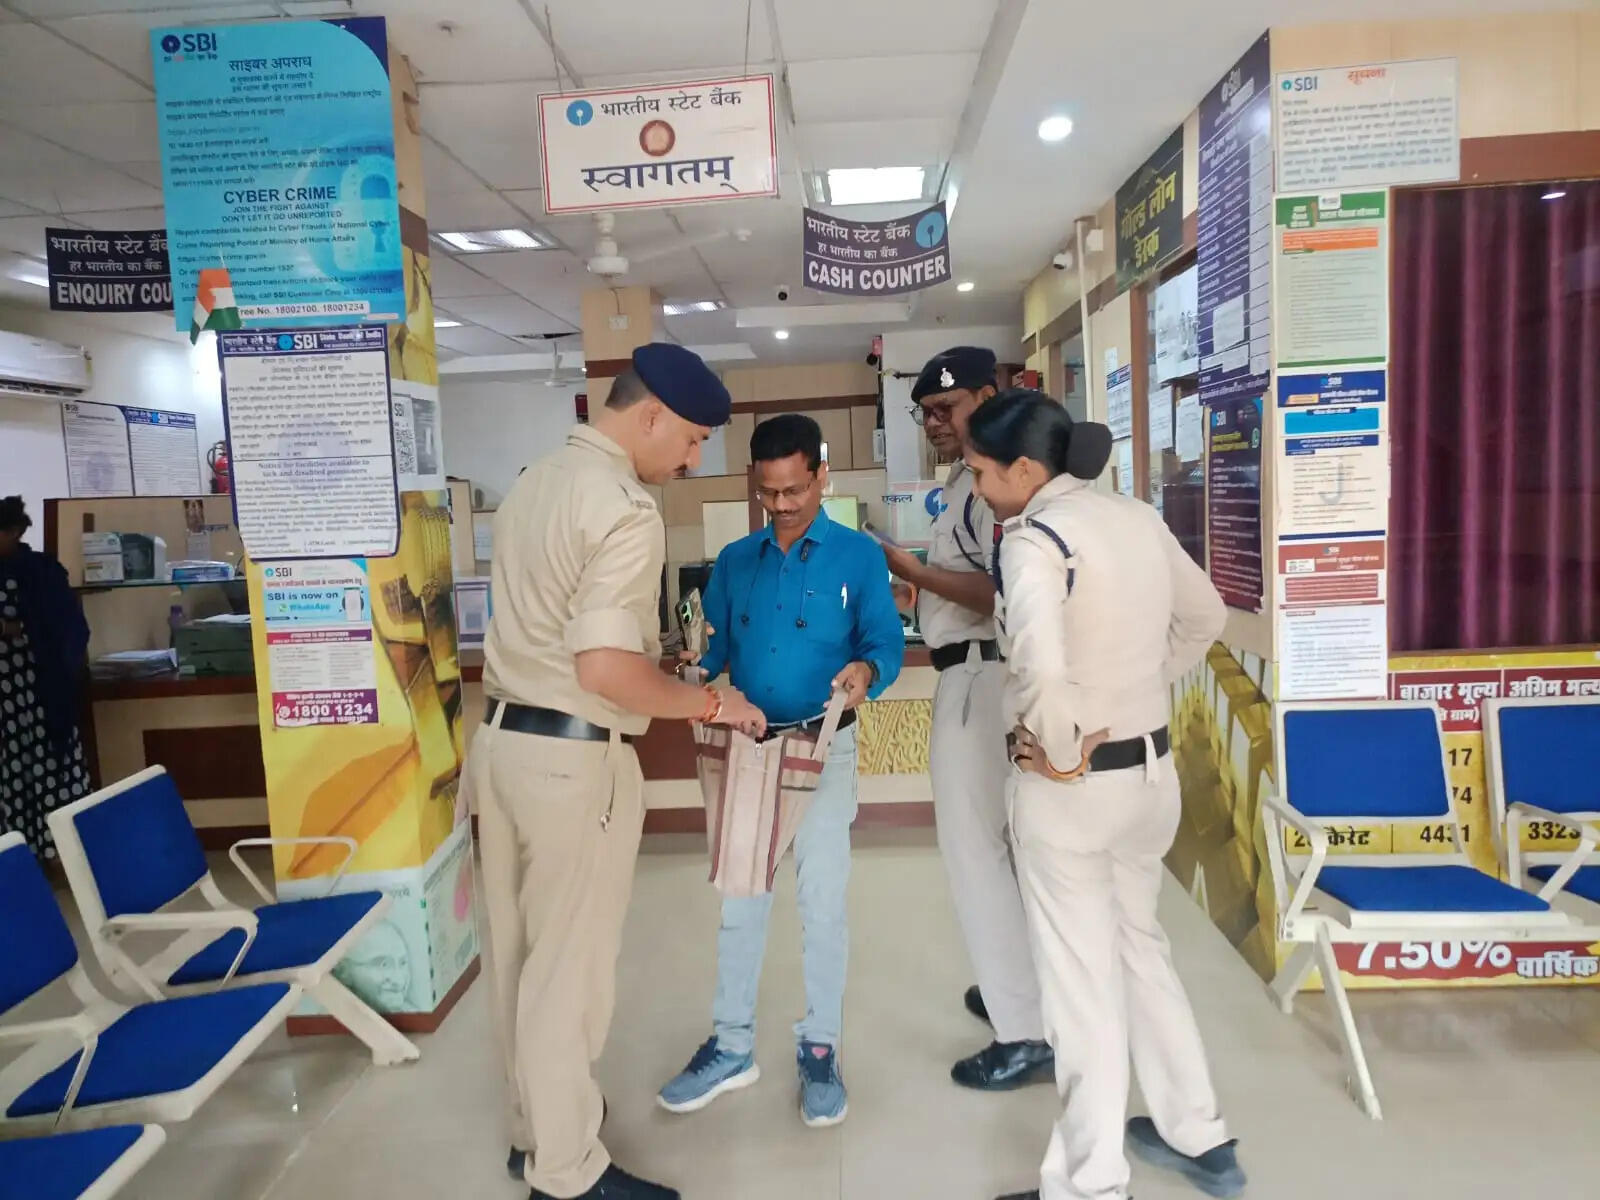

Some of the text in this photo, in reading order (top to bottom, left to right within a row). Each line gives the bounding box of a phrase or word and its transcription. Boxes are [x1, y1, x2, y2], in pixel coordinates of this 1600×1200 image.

[183, 33, 217, 53] SBI
[228, 57, 267, 72] साइबर
[271, 55, 312, 70] अपराध
[1294, 76, 1318, 91] SBI
[601, 87, 743, 117] भारतीय स्टेट बैंक
[581, 156, 740, 192] स्वागतम्
[223, 186, 337, 204] CYBER CRIME
[233, 202, 330, 214] JOIN THE FIGHT AGAINST
[287, 211, 342, 219] UNREPORTED
[806, 216, 911, 243] भारतीय स्टेट बैंक
[50, 235, 109, 254] भारतीय
[114, 234, 145, 255] स्टेट
[830, 244, 861, 259] भारतीय
[864, 248, 877, 259] का
[85, 259, 124, 272] भारतीय
[127, 261, 141, 272] का
[808, 254, 947, 290] CASH COUNTER
[57, 281, 136, 306] ENQUIRY
[239, 307, 254, 316] ree
[294, 333, 318, 350] SBI
[275, 567, 292, 577] SBI
[267, 591, 340, 601] SBI is now on
[1457, 681, 1500, 705] मूल्य
[292, 703, 374, 717] 1800 1234
[1294, 829, 1313, 847] 2
[1515, 951, 1600, 978] वार्षिक
